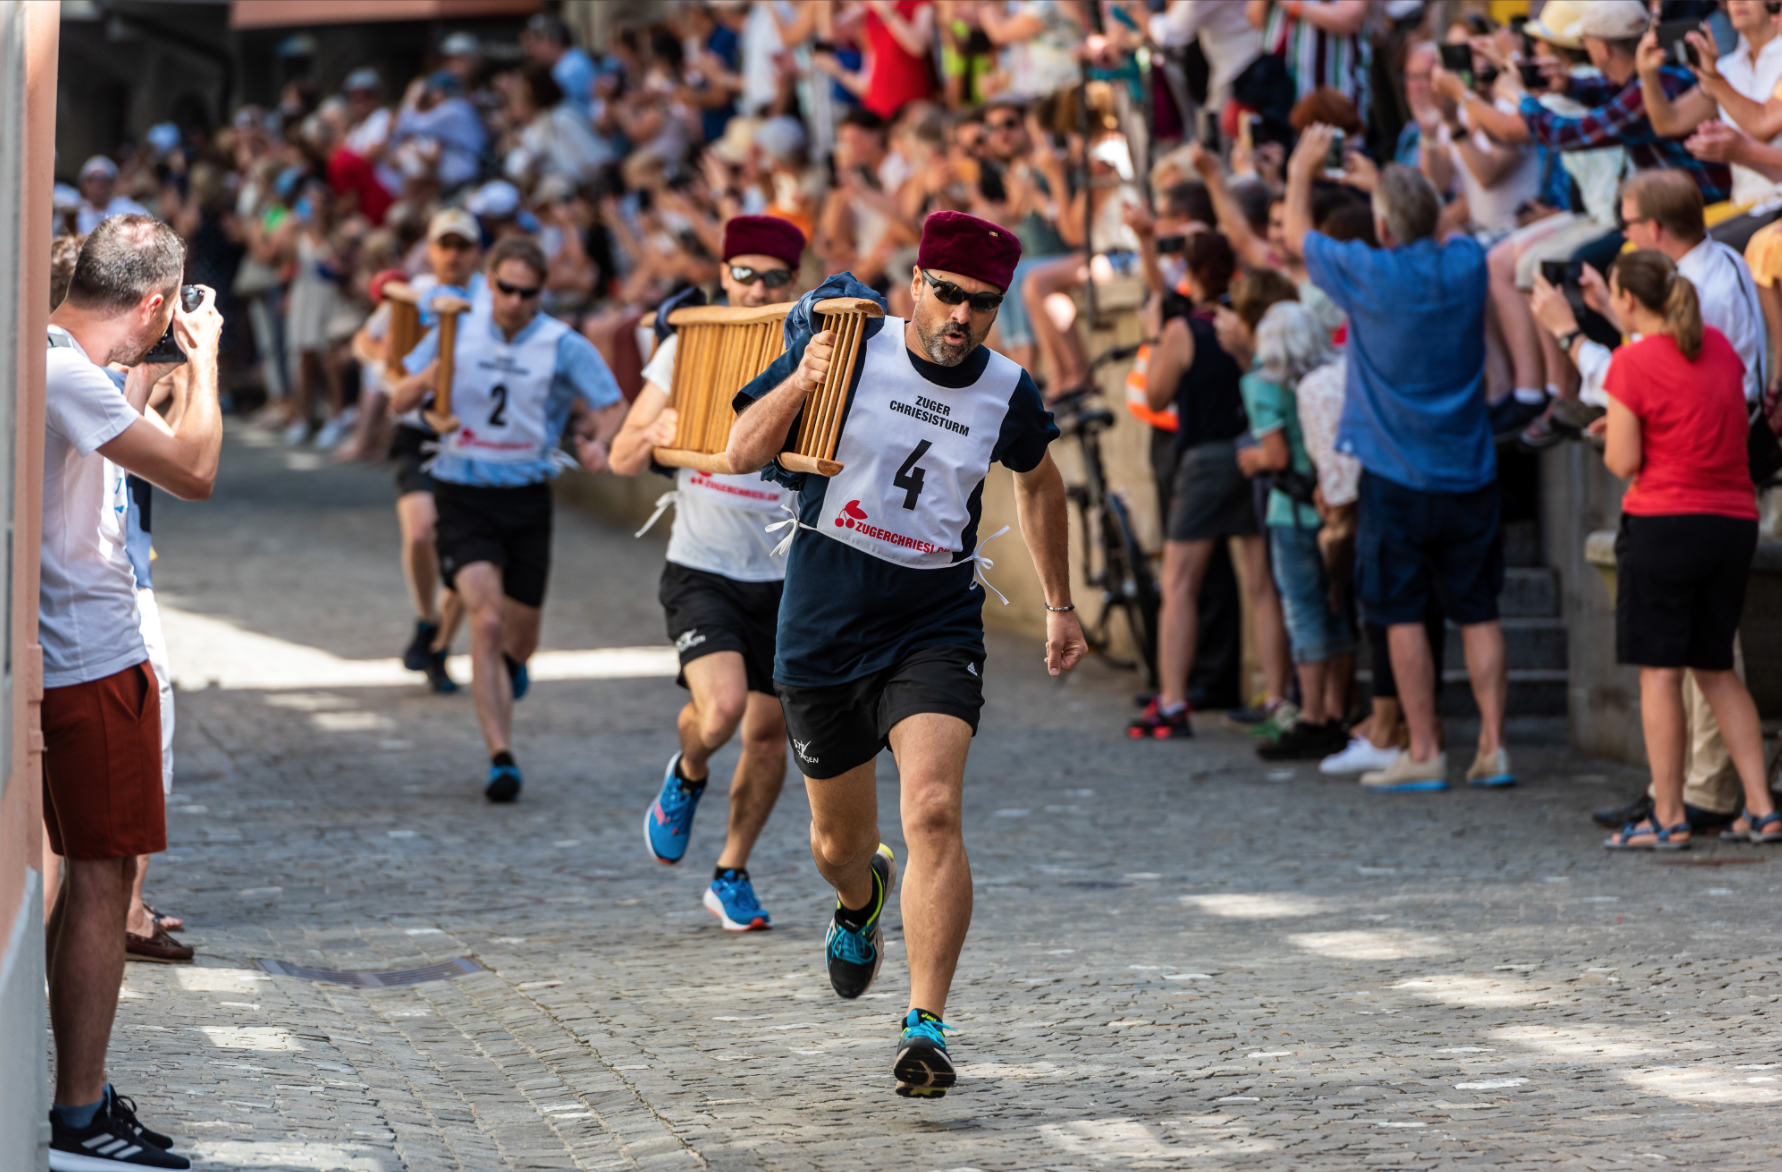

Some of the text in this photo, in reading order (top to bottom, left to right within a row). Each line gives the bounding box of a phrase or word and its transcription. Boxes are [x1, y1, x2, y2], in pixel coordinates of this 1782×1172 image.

[488, 383, 508, 428] 2
[889, 400, 970, 437] CHRIESISTURM
[915, 395, 951, 417] ZUGER
[893, 438, 933, 511] 4
